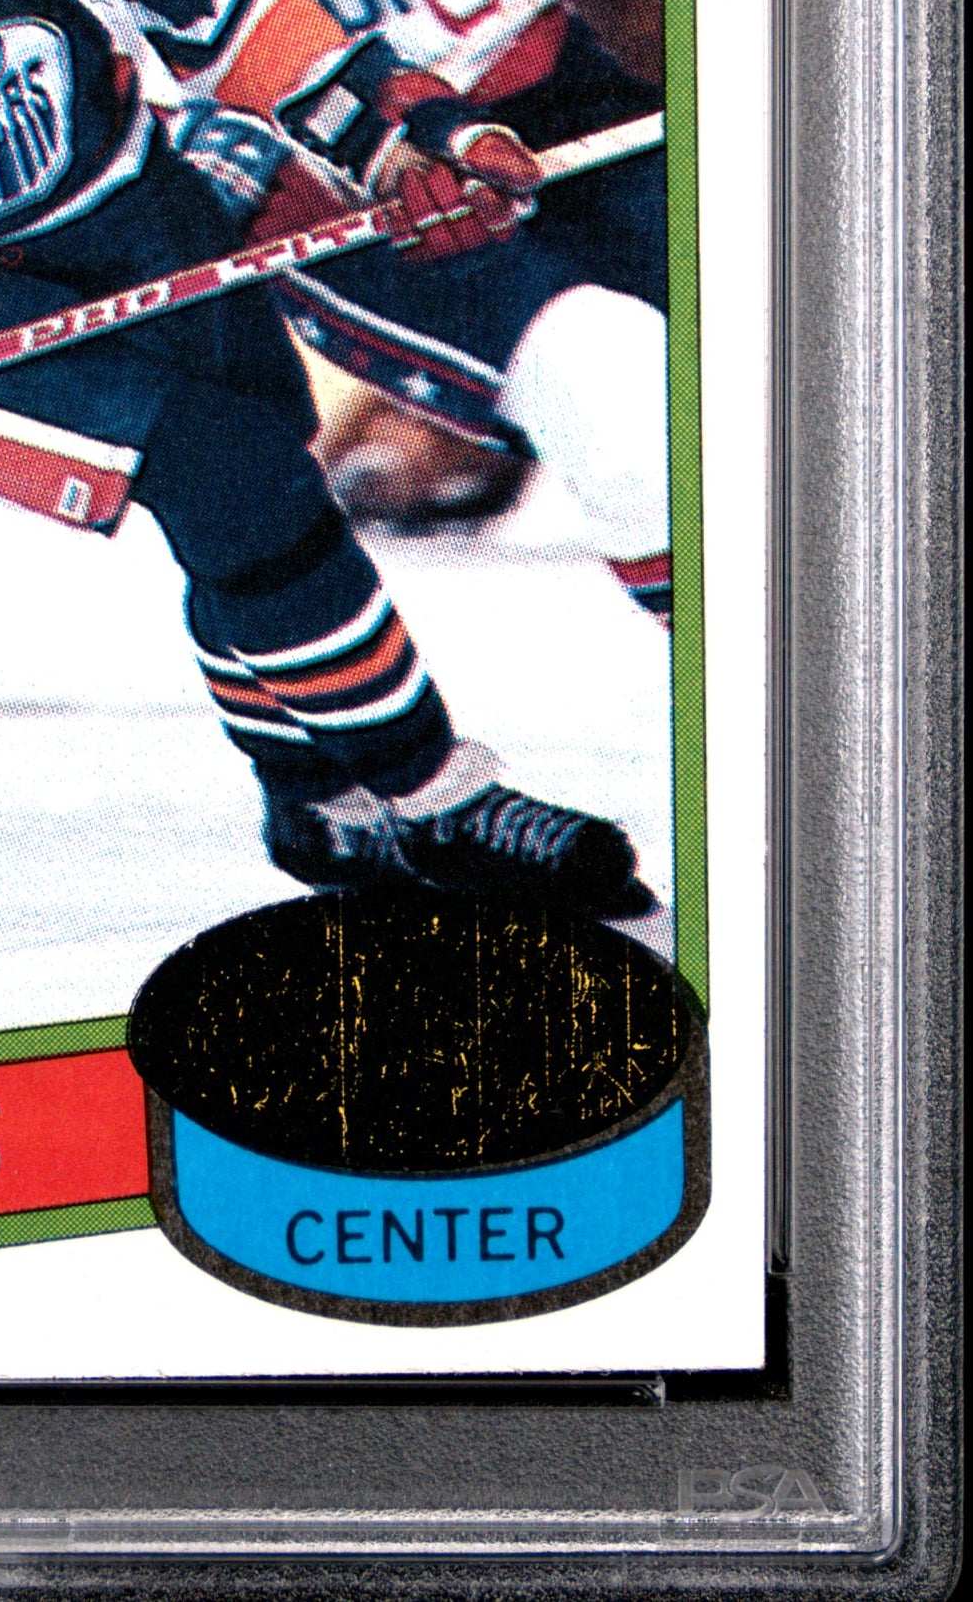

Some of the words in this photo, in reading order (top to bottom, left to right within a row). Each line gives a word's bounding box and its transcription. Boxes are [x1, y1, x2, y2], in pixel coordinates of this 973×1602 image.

[21, 279, 173, 353] PRO
[284, 1205, 566, 1266] CENTER
[677, 1463, 829, 1523] PSA
